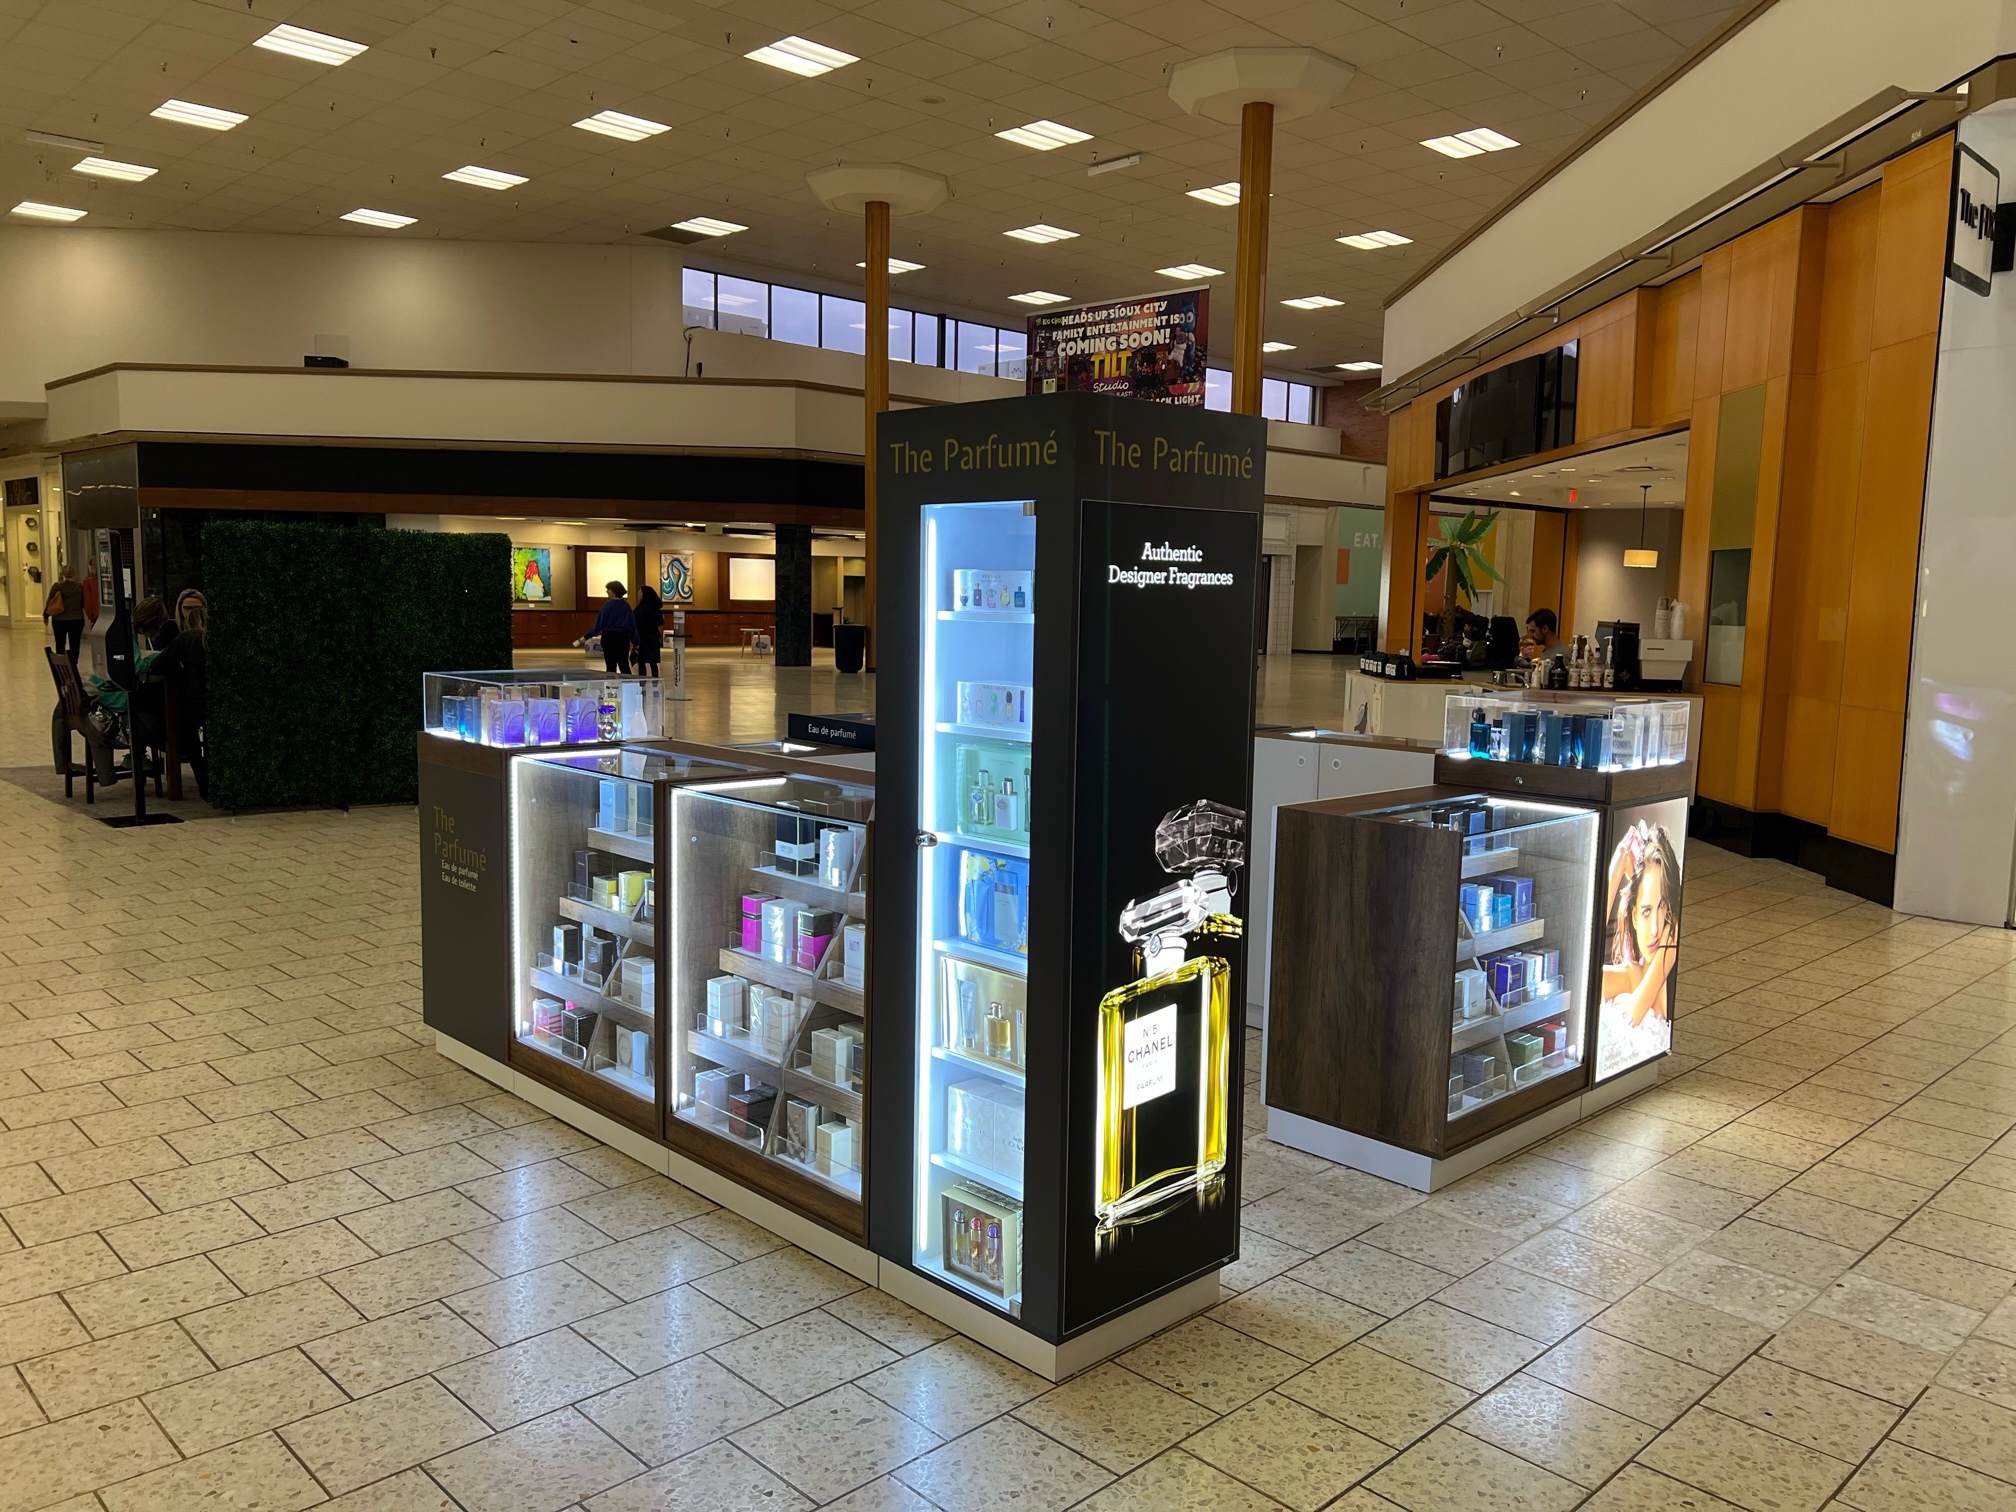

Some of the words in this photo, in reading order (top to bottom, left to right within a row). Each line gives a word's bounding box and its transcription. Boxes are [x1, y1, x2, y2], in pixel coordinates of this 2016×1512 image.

[1960, 187, 1978, 229] The
[1978, 203, 1996, 242] Fix
[1062, 309, 1093, 326] HEADS
[1095, 308, 1108, 320] UP
[1109, 304, 1141, 319] SIOUX
[1143, 300, 1168, 314] CITY
[1051, 326, 1085, 342] FAMILY
[1086, 317, 1168, 337] ENTERTAINMENT
[1170, 313, 1180, 325] IS
[1057, 336, 1117, 358] COMING
[1119, 328, 1171, 349] SOON!
[1090, 350, 1132, 380] TILT
[1092, 379, 1130, 394] Studio
[1174, 394, 1201, 405] LIGHT
[889, 441, 933, 474] The
[943, 430, 1058, 472] Parfumé
[1094, 429, 1141, 469] The
[1153, 436, 1253, 479] Parfumé
[1141, 540, 1204, 563] Authentic
[1108, 564, 1167, 589] Designer
[1168, 566, 1234, 590] Fragrances
[808, 724, 819, 734] Eau
[820, 726, 829, 736] de
[830, 728, 857, 740] parfumé
[433, 806, 455, 833] The
[434, 832, 487, 871] Parfumé
[441, 859, 450, 871] Eau
[451, 863, 458, 873] de
[441, 871, 450, 883] Eau
[451, 876, 458, 885] de
[458, 877, 477, 892] toilette
[1127, 1034, 1173, 1063] CHANEL
[1136, 1074, 1163, 1091] PARFUM
